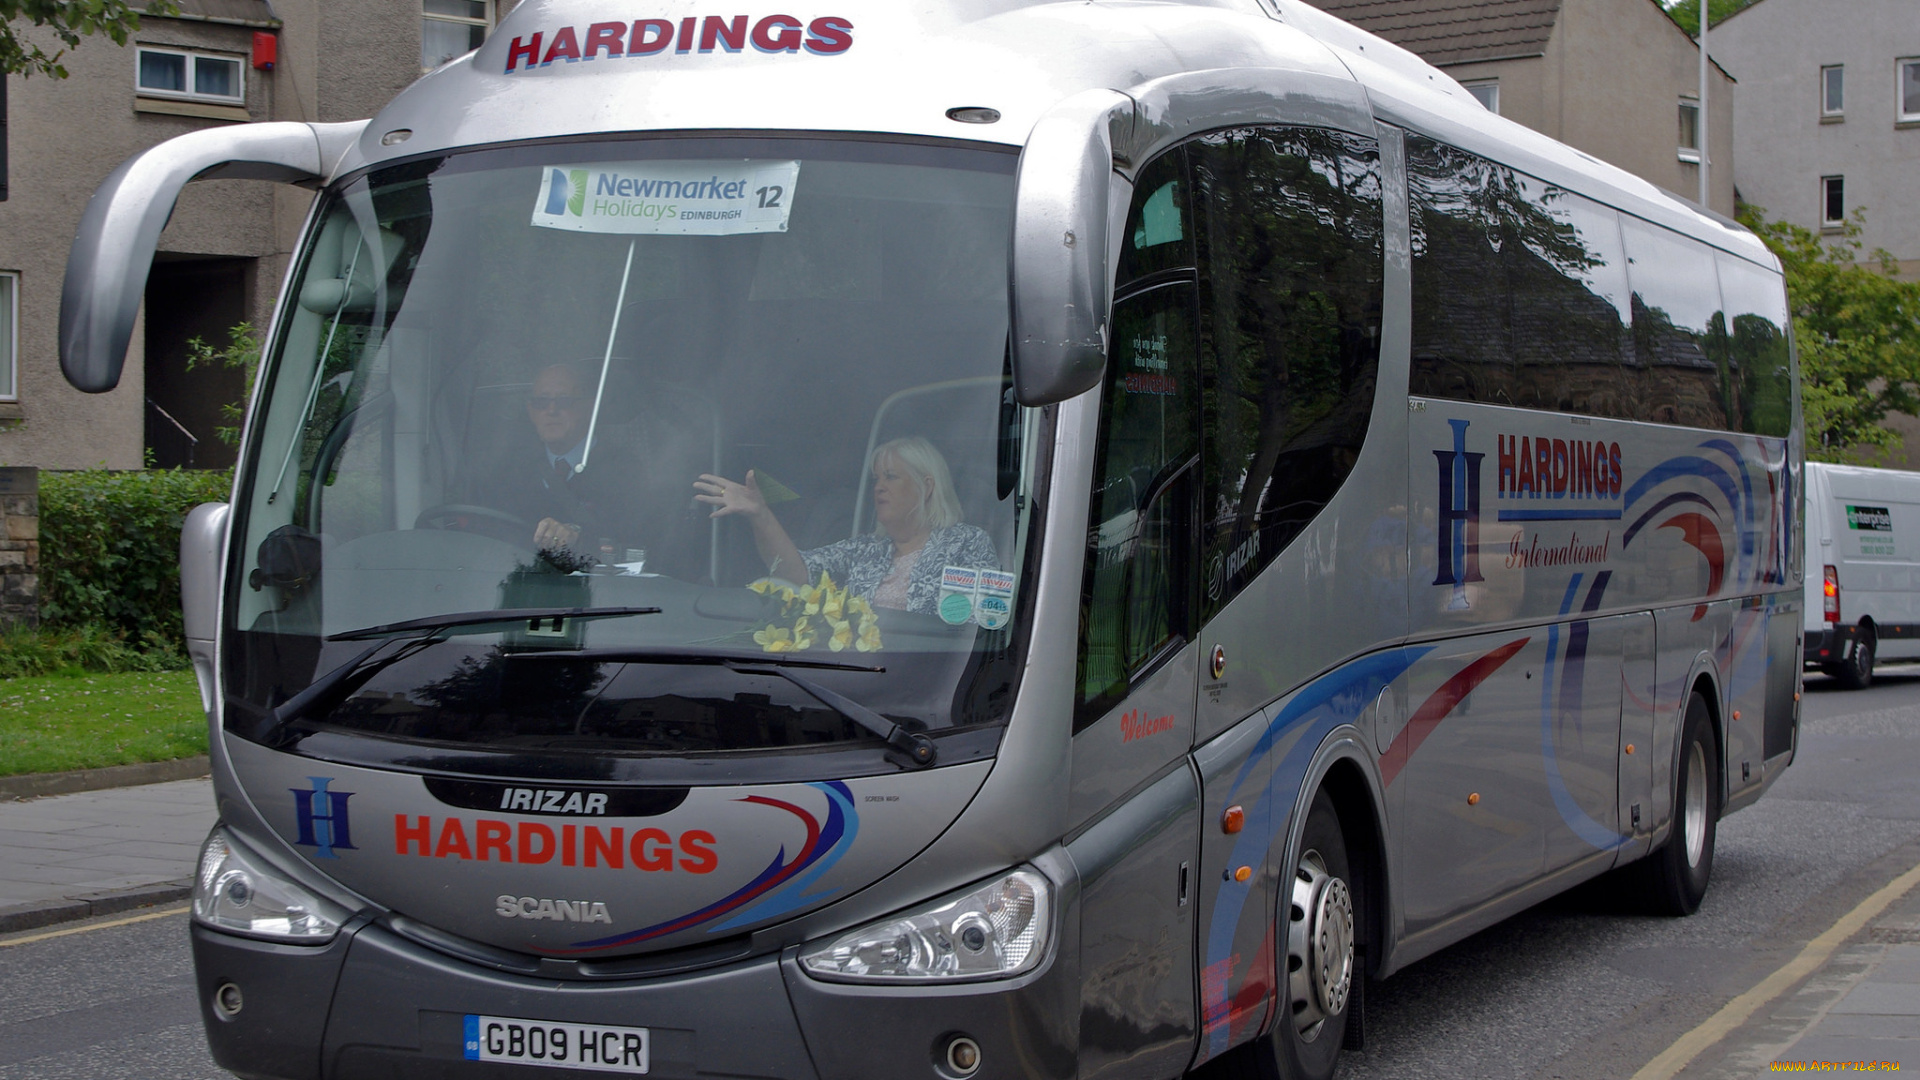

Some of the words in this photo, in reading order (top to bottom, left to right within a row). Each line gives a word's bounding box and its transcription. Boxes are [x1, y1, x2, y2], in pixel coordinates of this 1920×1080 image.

[503, 14, 854, 75] HARDINGS
[595, 173, 747, 200] Newmarket
[754, 185, 783, 209] 12
[592, 199, 678, 221] Holidays
[680, 209, 742, 221] EDINBURGH
[1498, 433, 1623, 500] HARDINGS
[1848, 511, 1889, 528] enterprise
[1226, 529, 1261, 582] IRIZAR
[1505, 530, 1611, 570] International
[1120, 708, 1175, 744] Welcome
[499, 787, 609, 816] IRIZAR
[394, 813, 719, 875] HARDINGS
[495, 894, 613, 926] SCANIA
[487, 1022, 567, 1061] GB09
[579, 1029, 642, 1067] HCR
